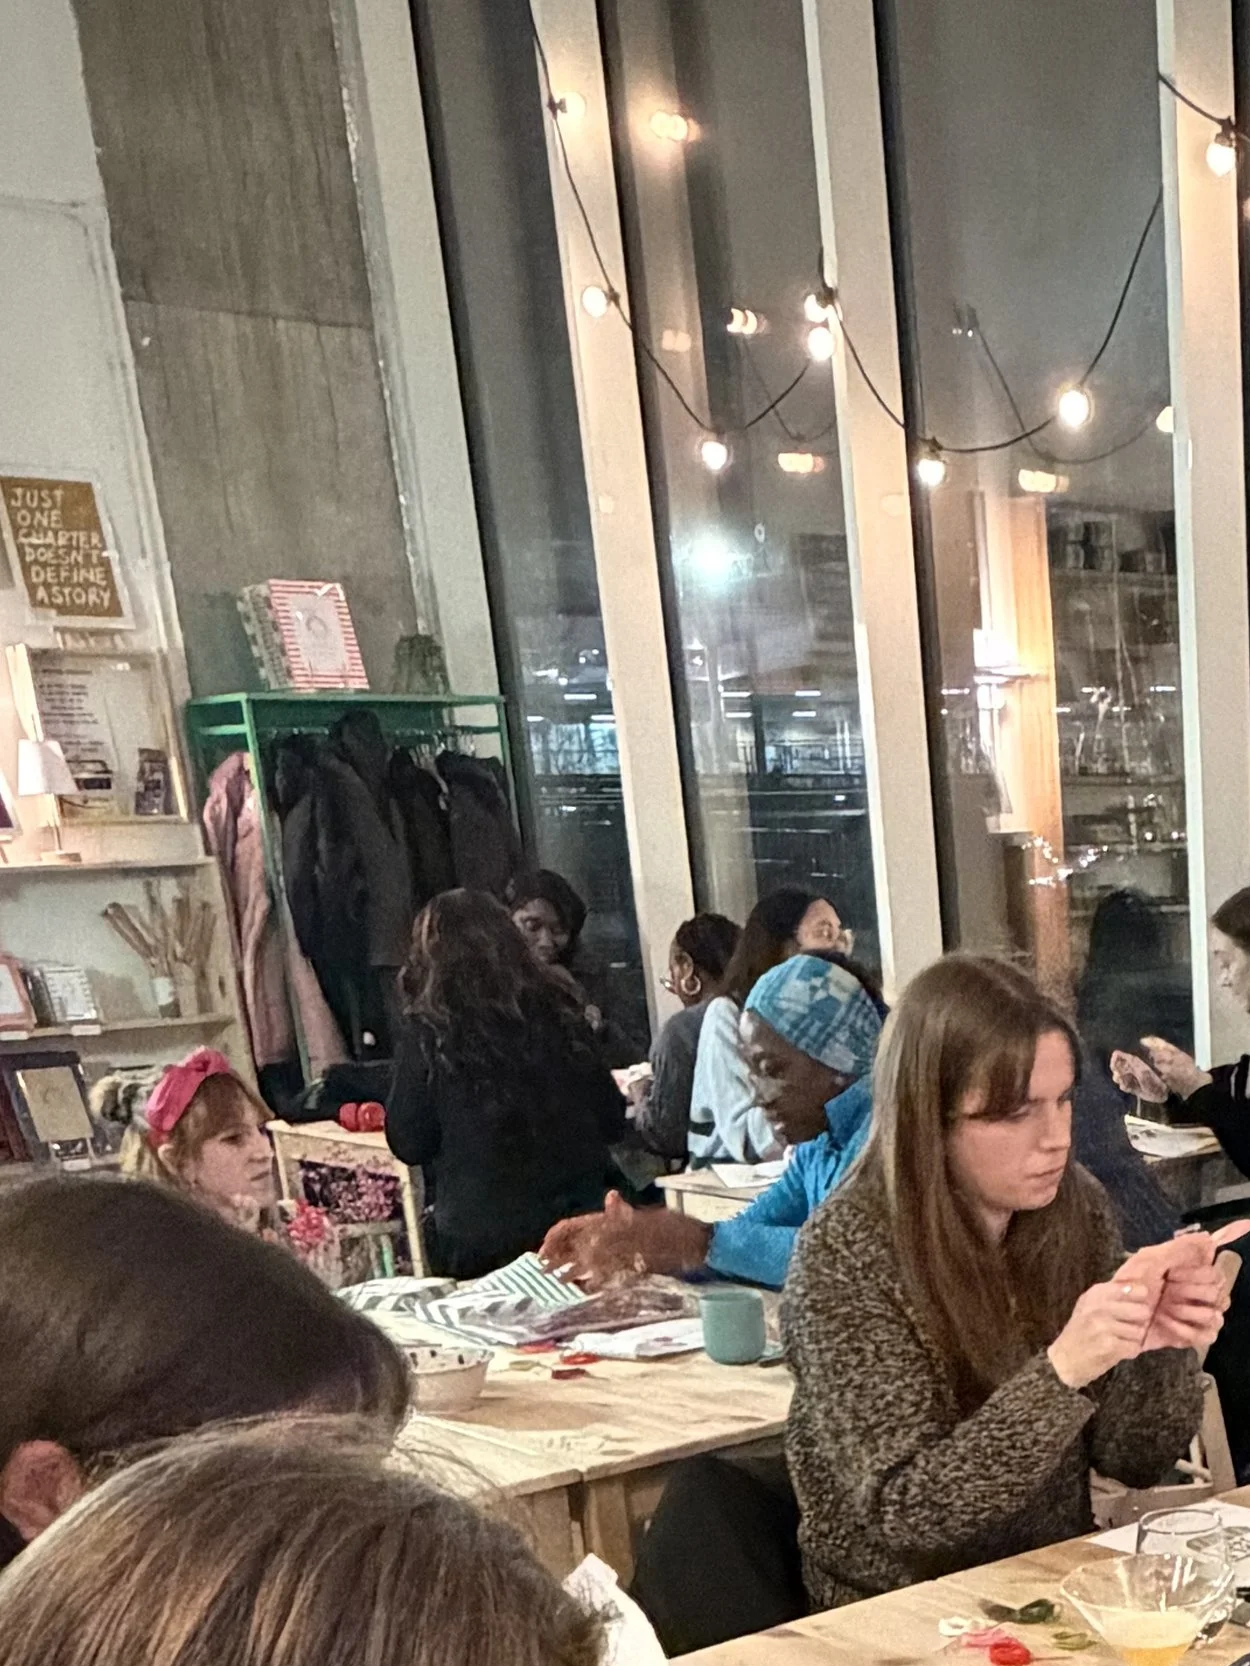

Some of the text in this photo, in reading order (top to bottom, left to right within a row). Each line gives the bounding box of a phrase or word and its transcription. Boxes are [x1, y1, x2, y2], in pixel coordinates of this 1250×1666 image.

[11, 487, 63, 508] JUST
[17, 509, 61, 528] ONE
[31, 566, 107, 585] DEFINE
